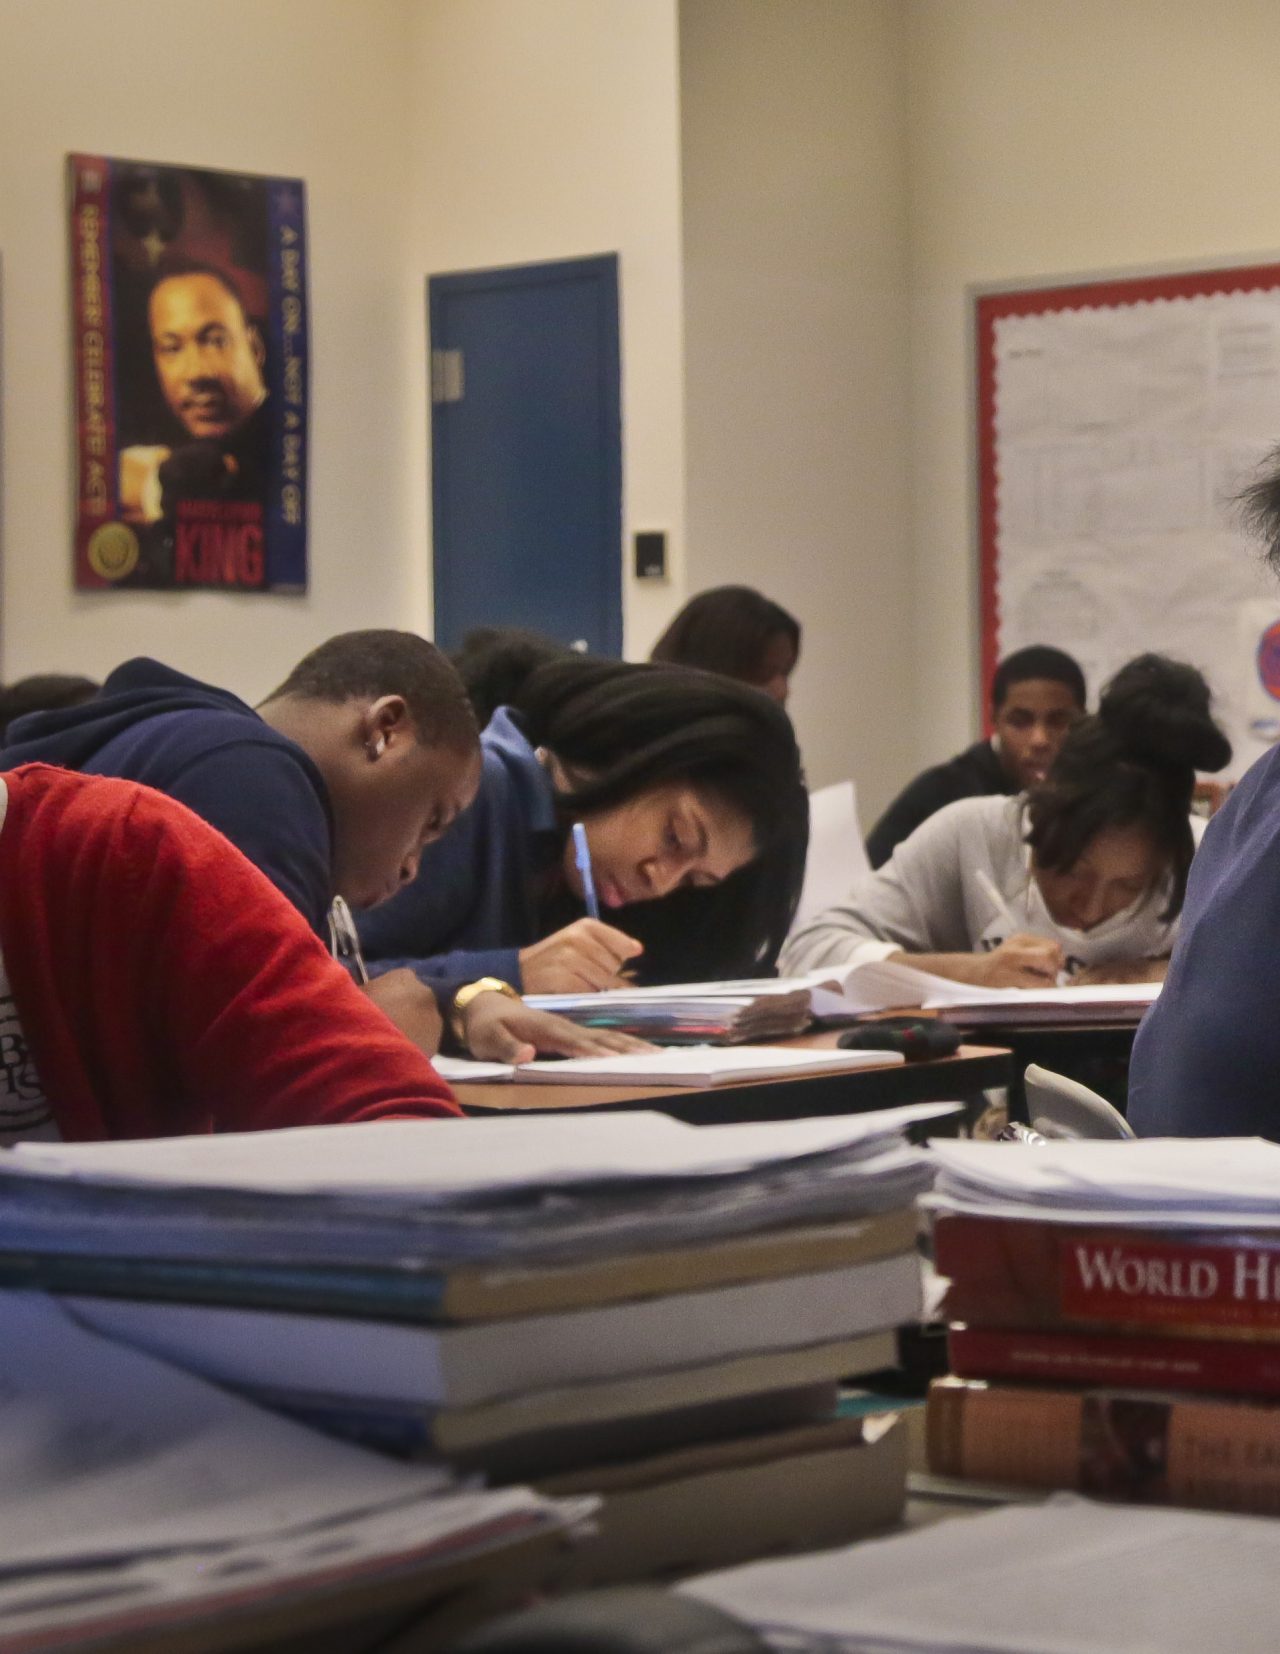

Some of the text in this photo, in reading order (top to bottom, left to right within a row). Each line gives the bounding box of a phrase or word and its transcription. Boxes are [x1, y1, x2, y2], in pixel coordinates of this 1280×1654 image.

[280, 223, 300, 246] A
[280, 248, 301, 290] DAY
[282, 409, 303, 431] A
[281, 433, 303, 482] DAY
[176, 523, 264, 585] KING
[1074, 1245, 1220, 1299] WORLD
